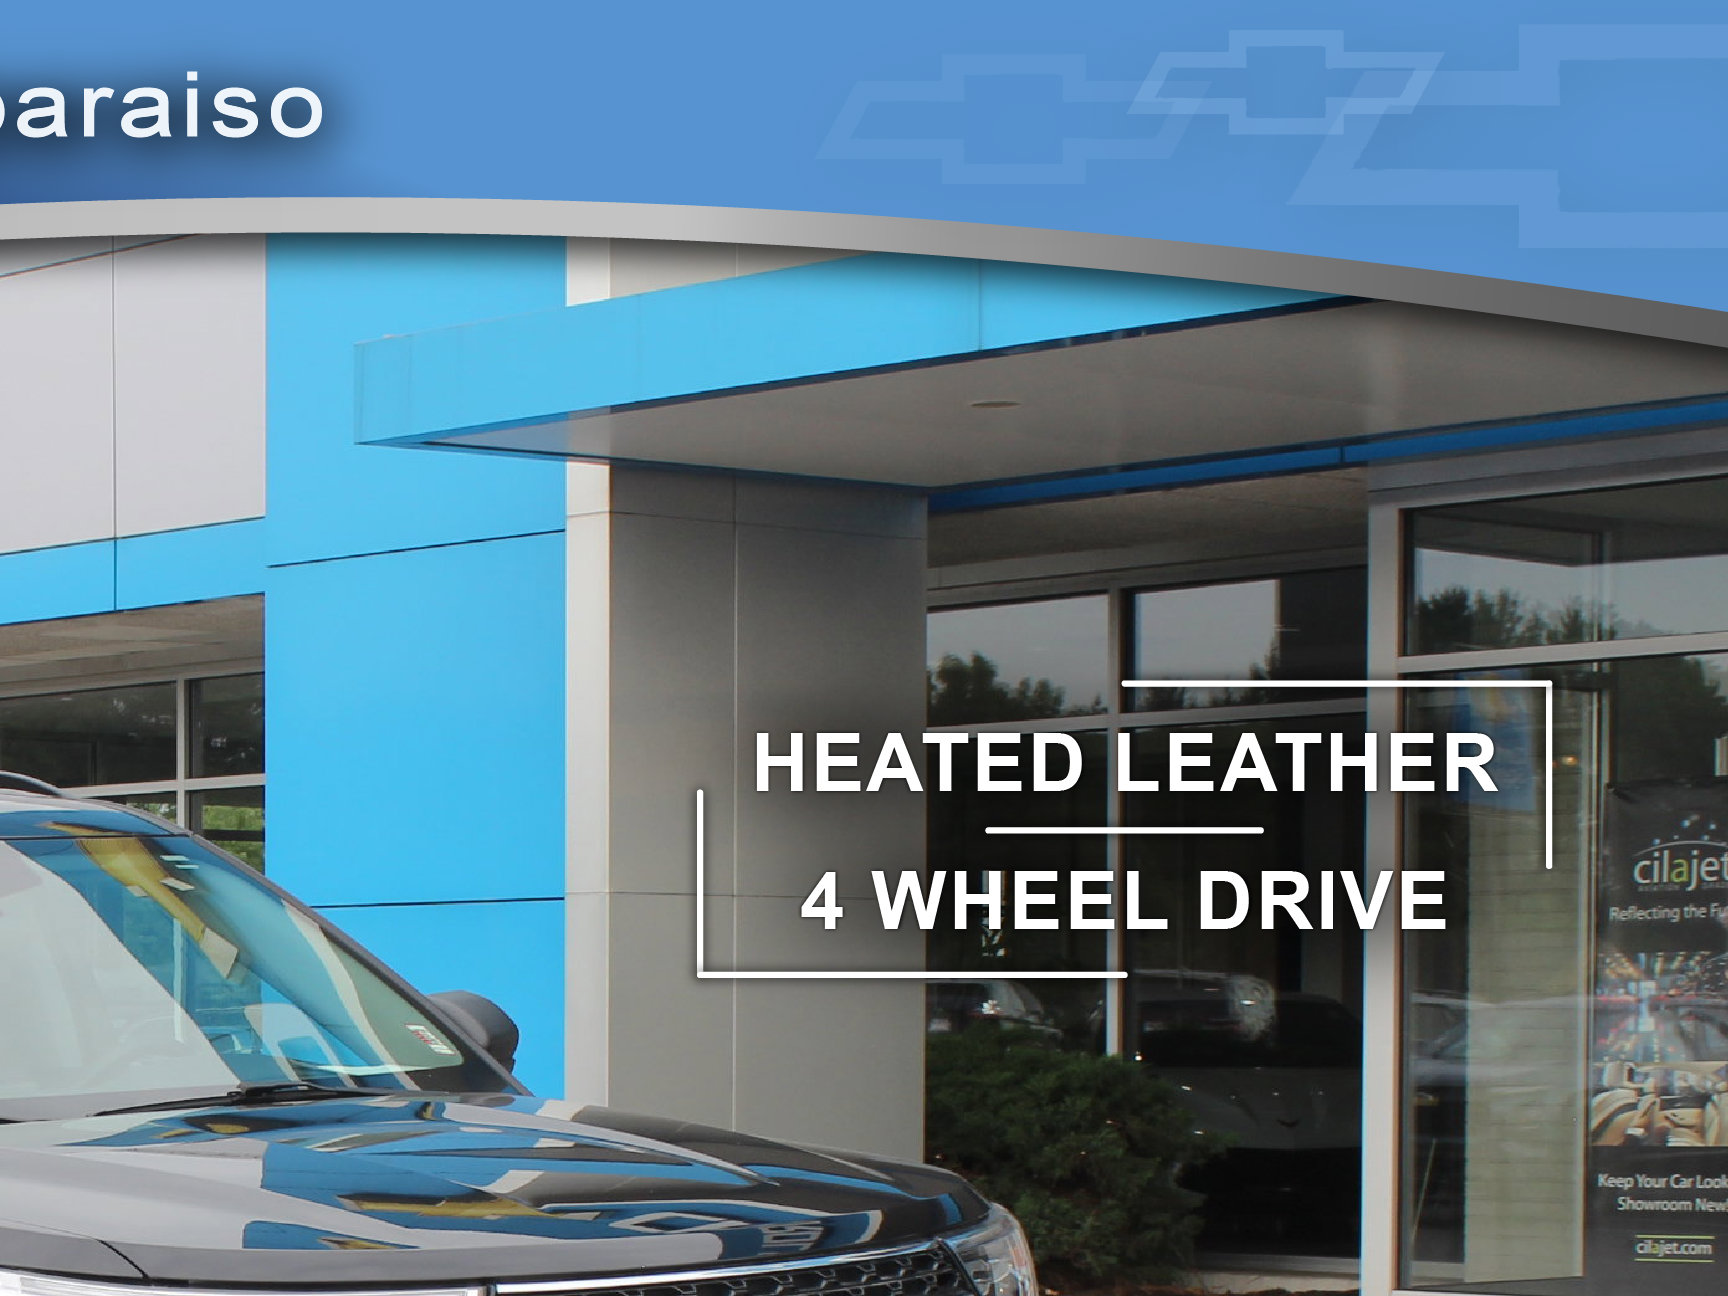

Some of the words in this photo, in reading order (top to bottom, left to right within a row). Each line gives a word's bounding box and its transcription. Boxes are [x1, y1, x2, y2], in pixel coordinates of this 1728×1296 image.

[1609, 905, 1680, 922] Reflecting
[1683, 904, 1707, 918] the
[1597, 1173, 1634, 1190] Keep
[1635, 1173, 1668, 1188] Your
[1670, 1173, 1692, 1188] Car
[1617, 1196, 1692, 1211] Showroom
[1635, 1240, 1713, 1257] cilajet.com
